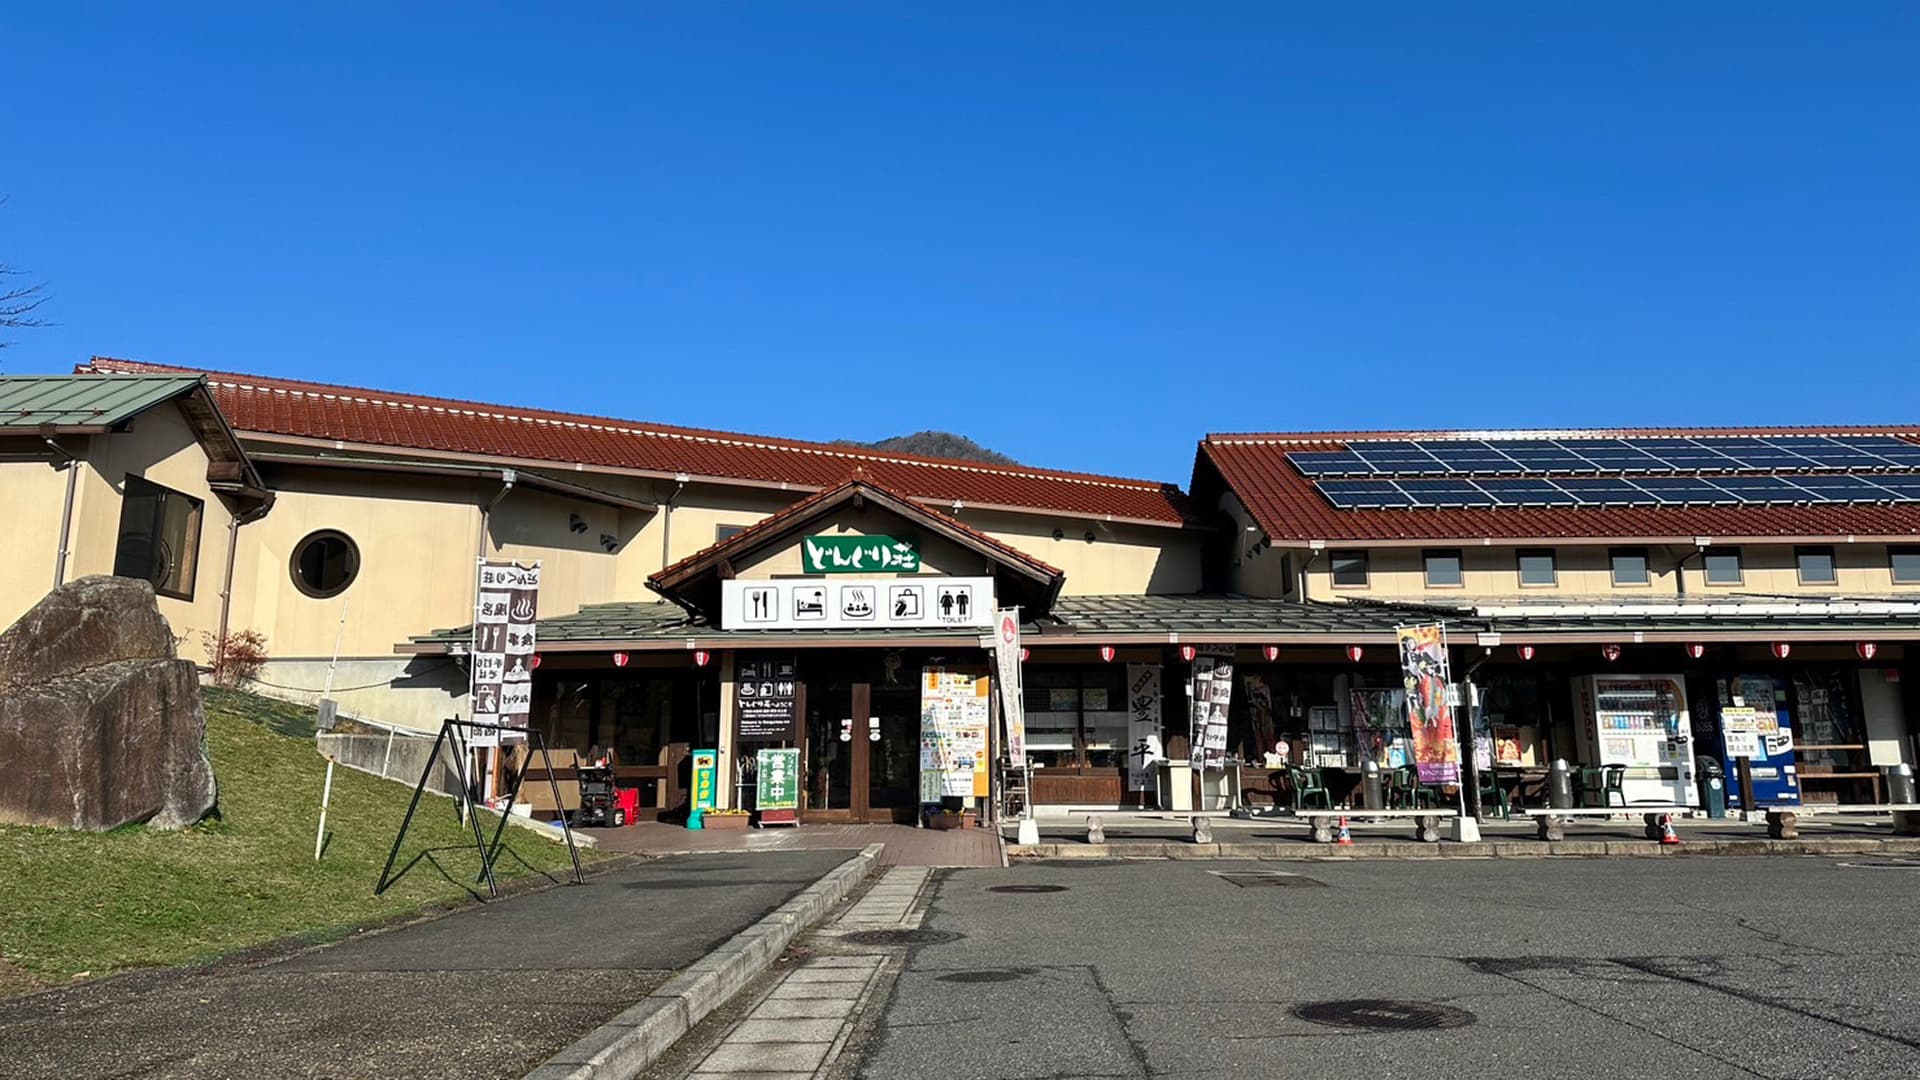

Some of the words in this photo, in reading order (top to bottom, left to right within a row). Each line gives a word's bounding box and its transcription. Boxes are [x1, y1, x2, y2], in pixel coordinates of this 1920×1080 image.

[806, 538, 916, 570] どんぐり荘
[942, 616, 967, 624] TOILET
[770, 753, 785, 800] 営業中
